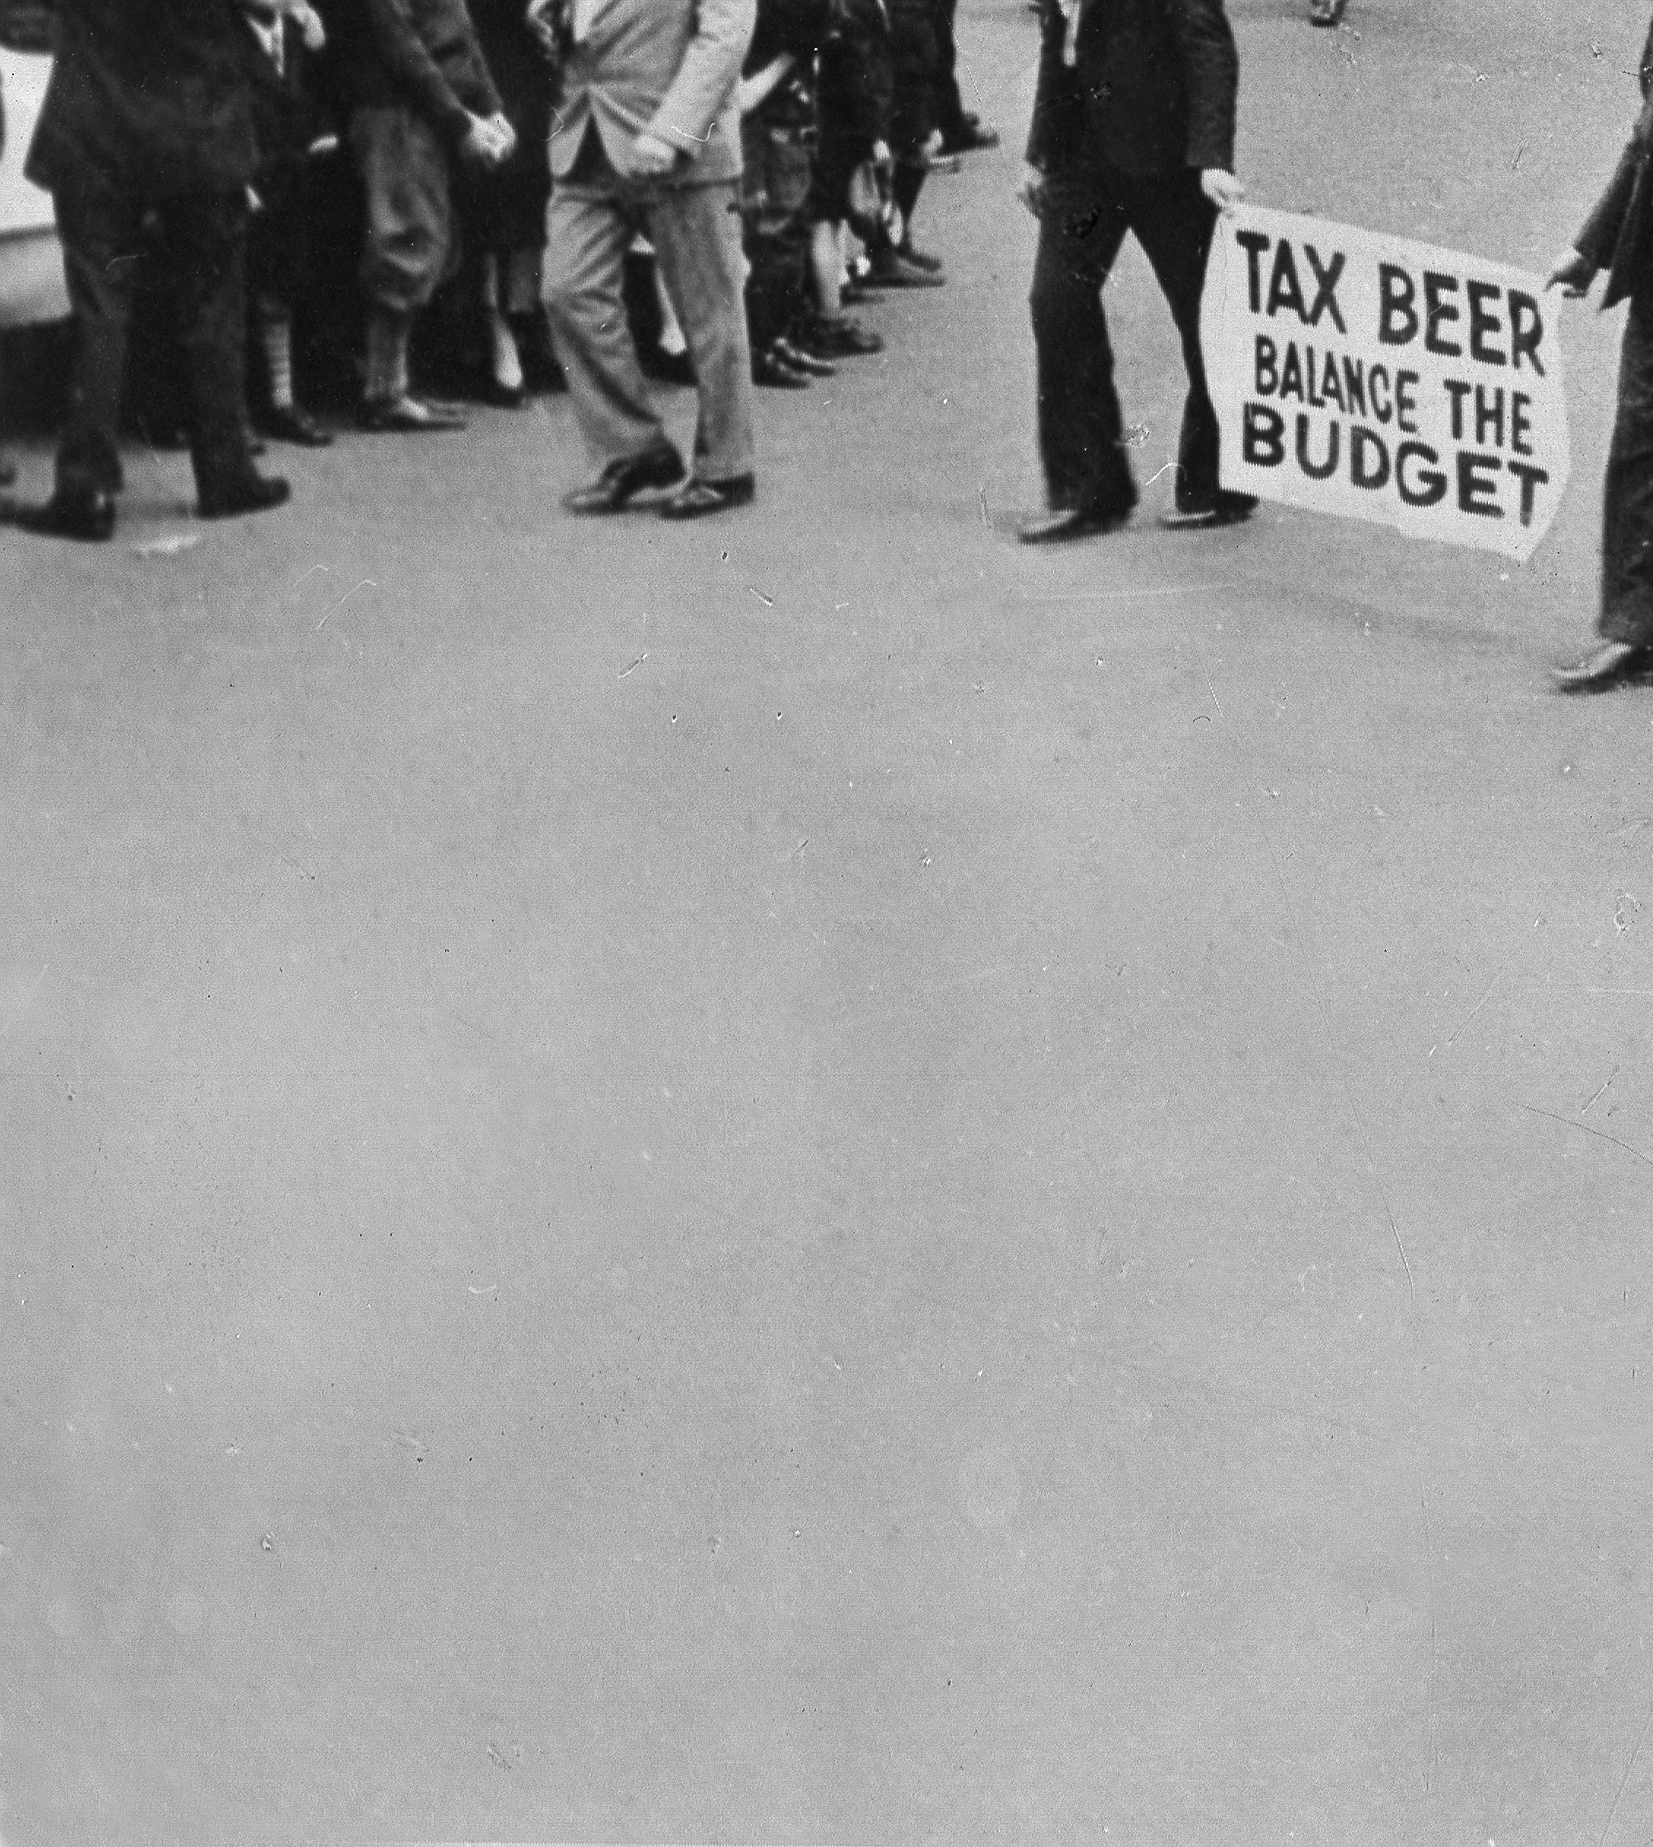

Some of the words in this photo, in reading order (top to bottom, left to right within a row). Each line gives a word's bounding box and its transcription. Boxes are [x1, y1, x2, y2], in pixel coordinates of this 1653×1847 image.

[1236, 229, 1347, 334] TAX
[1378, 262, 1545, 377] BEER
[1255, 333, 1419, 434] BALANCE
[1443, 378, 1533, 456] THE
[1242, 401, 1549, 528] BUDGET
